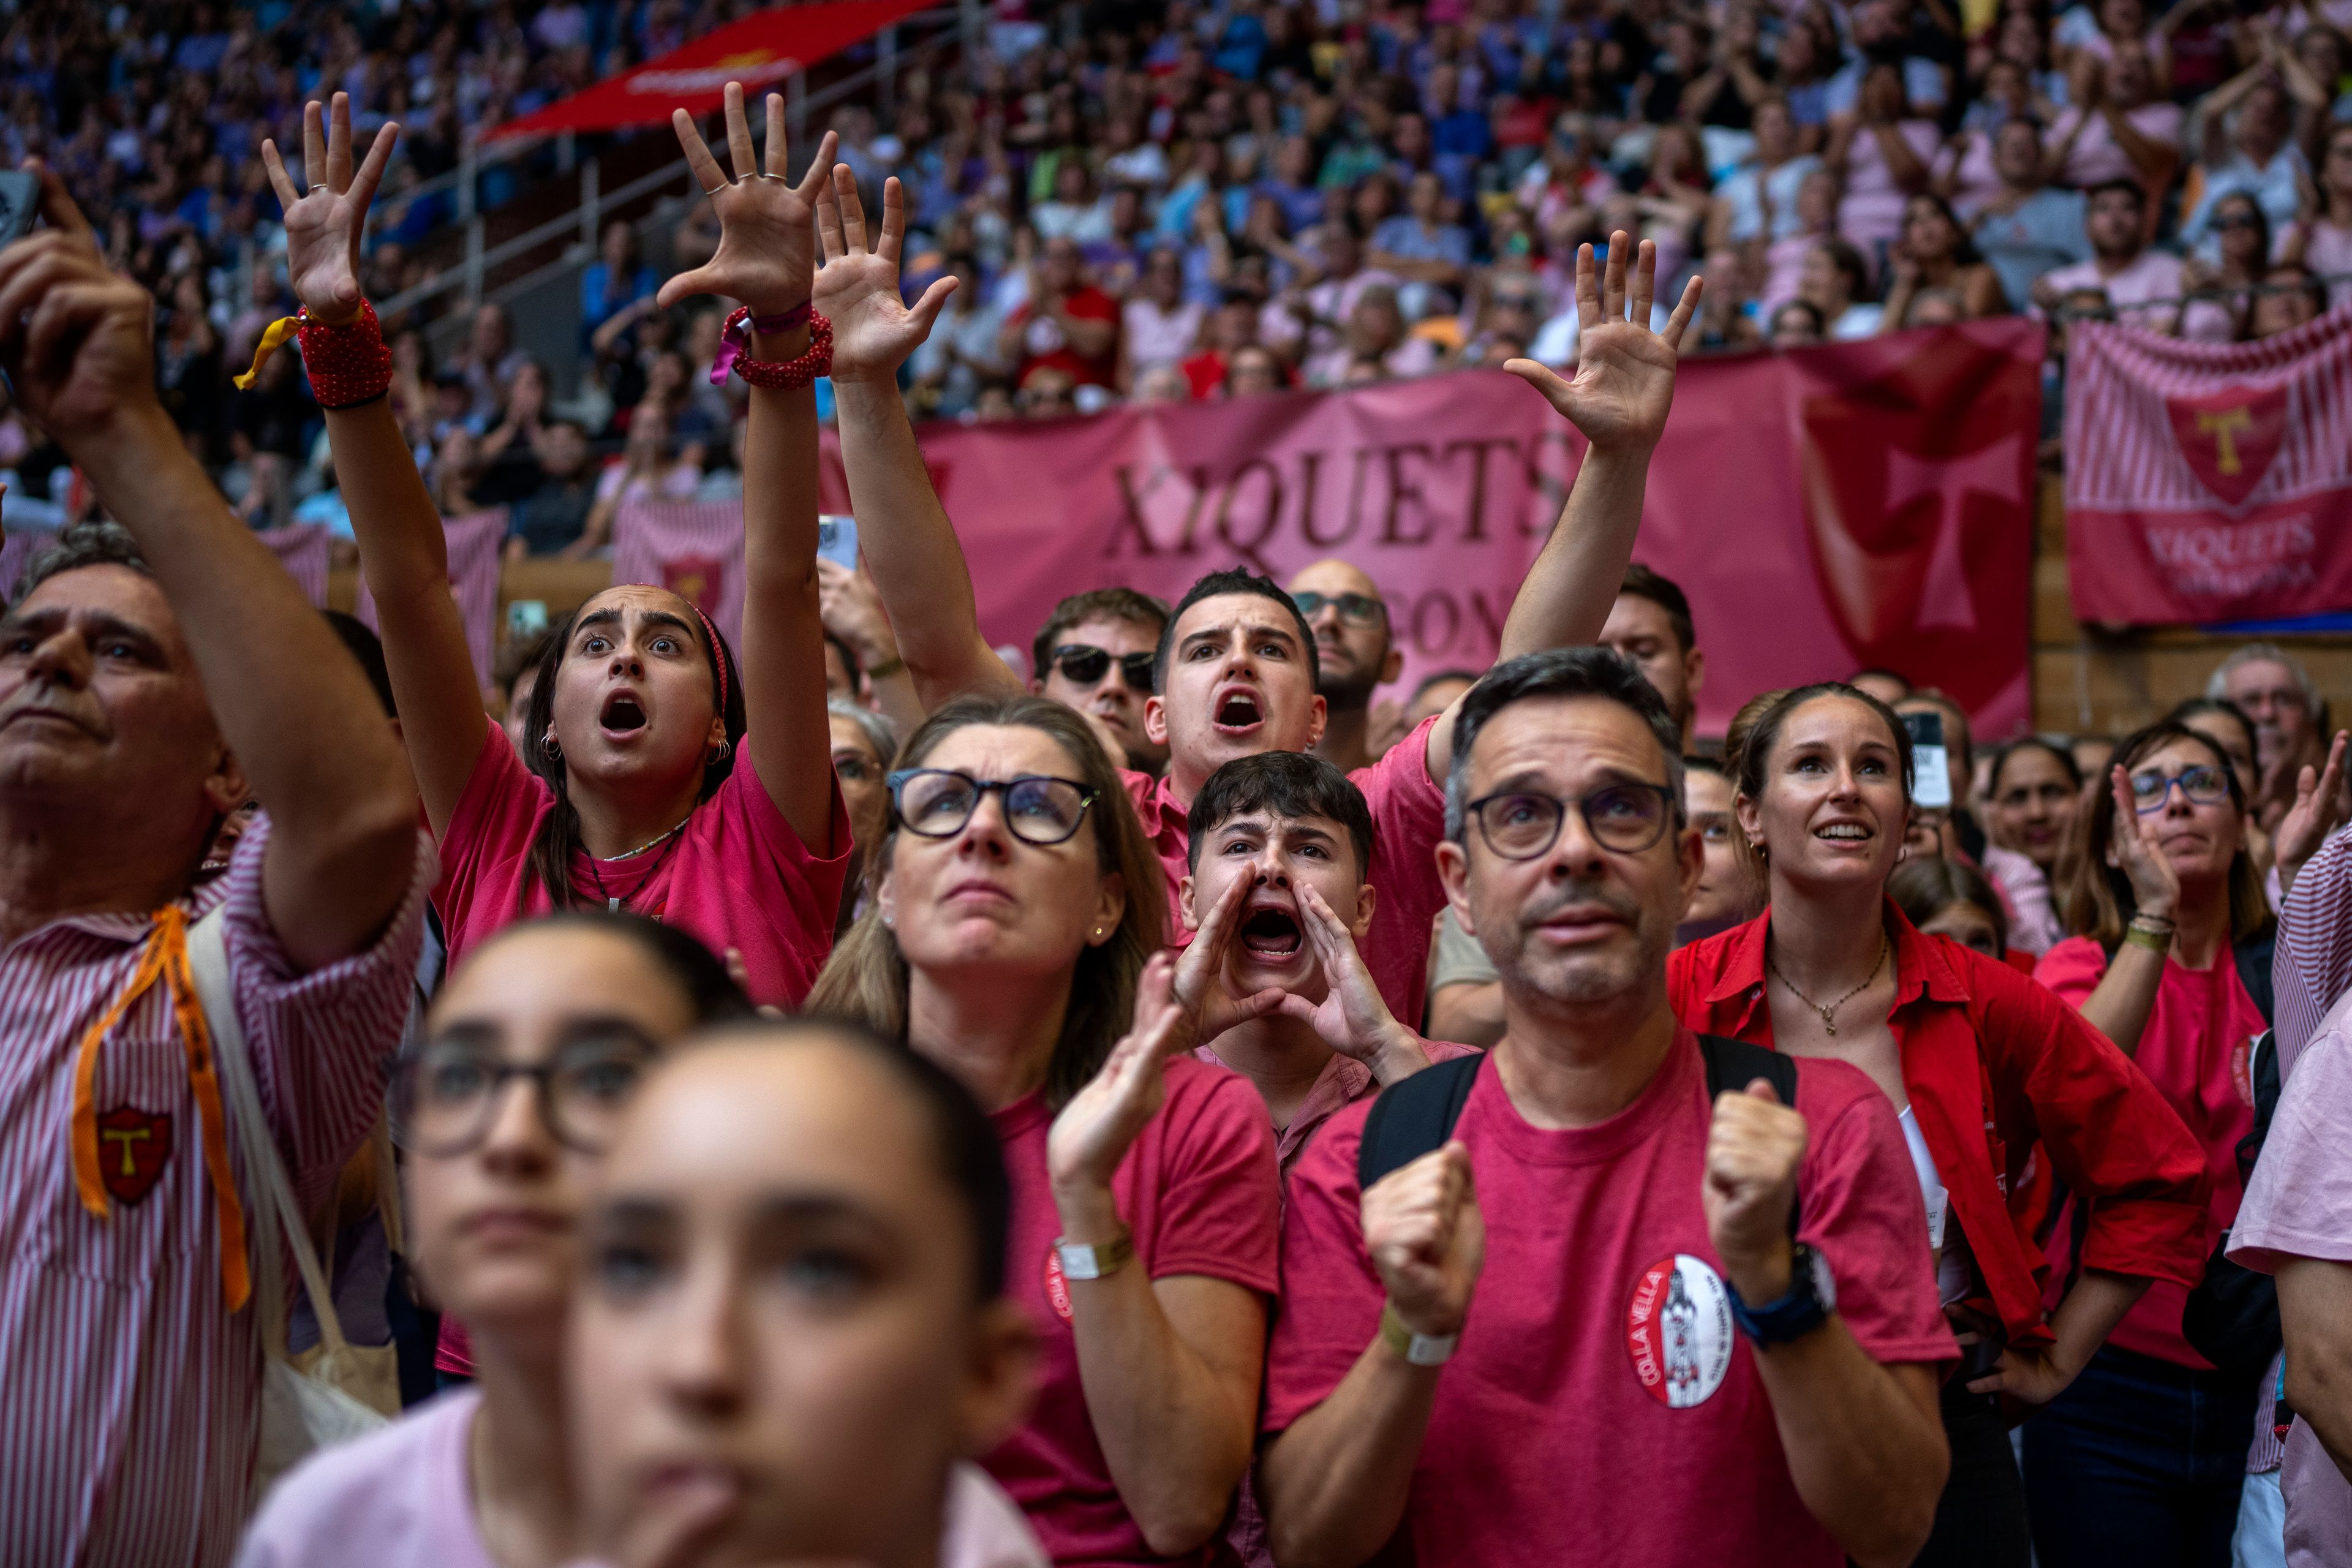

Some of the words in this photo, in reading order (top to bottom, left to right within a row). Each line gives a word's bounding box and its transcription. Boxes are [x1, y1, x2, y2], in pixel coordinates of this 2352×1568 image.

[1104, 432, 1577, 575] XIQUETS
[1630, 1271, 1664, 1325] VELLA
[1631, 1325, 1662, 1386] COLLA
